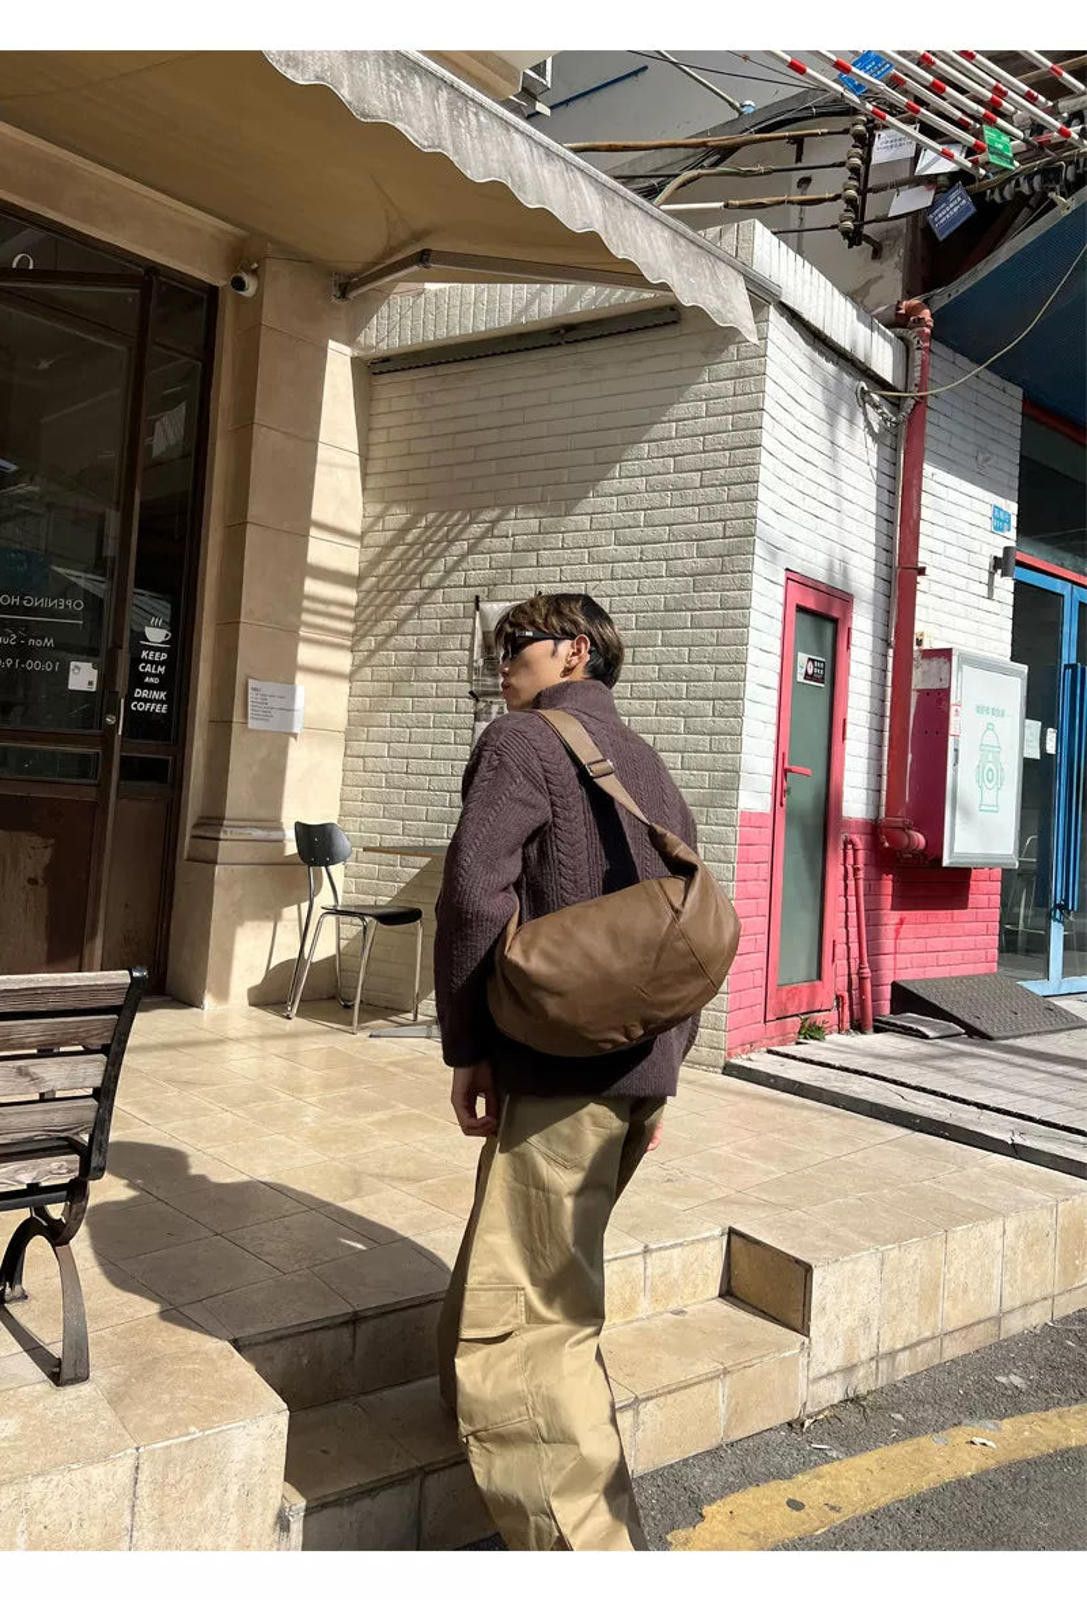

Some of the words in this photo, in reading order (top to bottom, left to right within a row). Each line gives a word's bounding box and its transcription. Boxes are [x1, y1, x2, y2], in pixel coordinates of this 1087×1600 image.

[140, 650, 168, 661] KEEP
[138, 662, 166, 675] CALM
[143, 676, 160, 684] AND
[133, 688, 168, 701] DRINK
[130, 701, 168, 714] COFFEE
